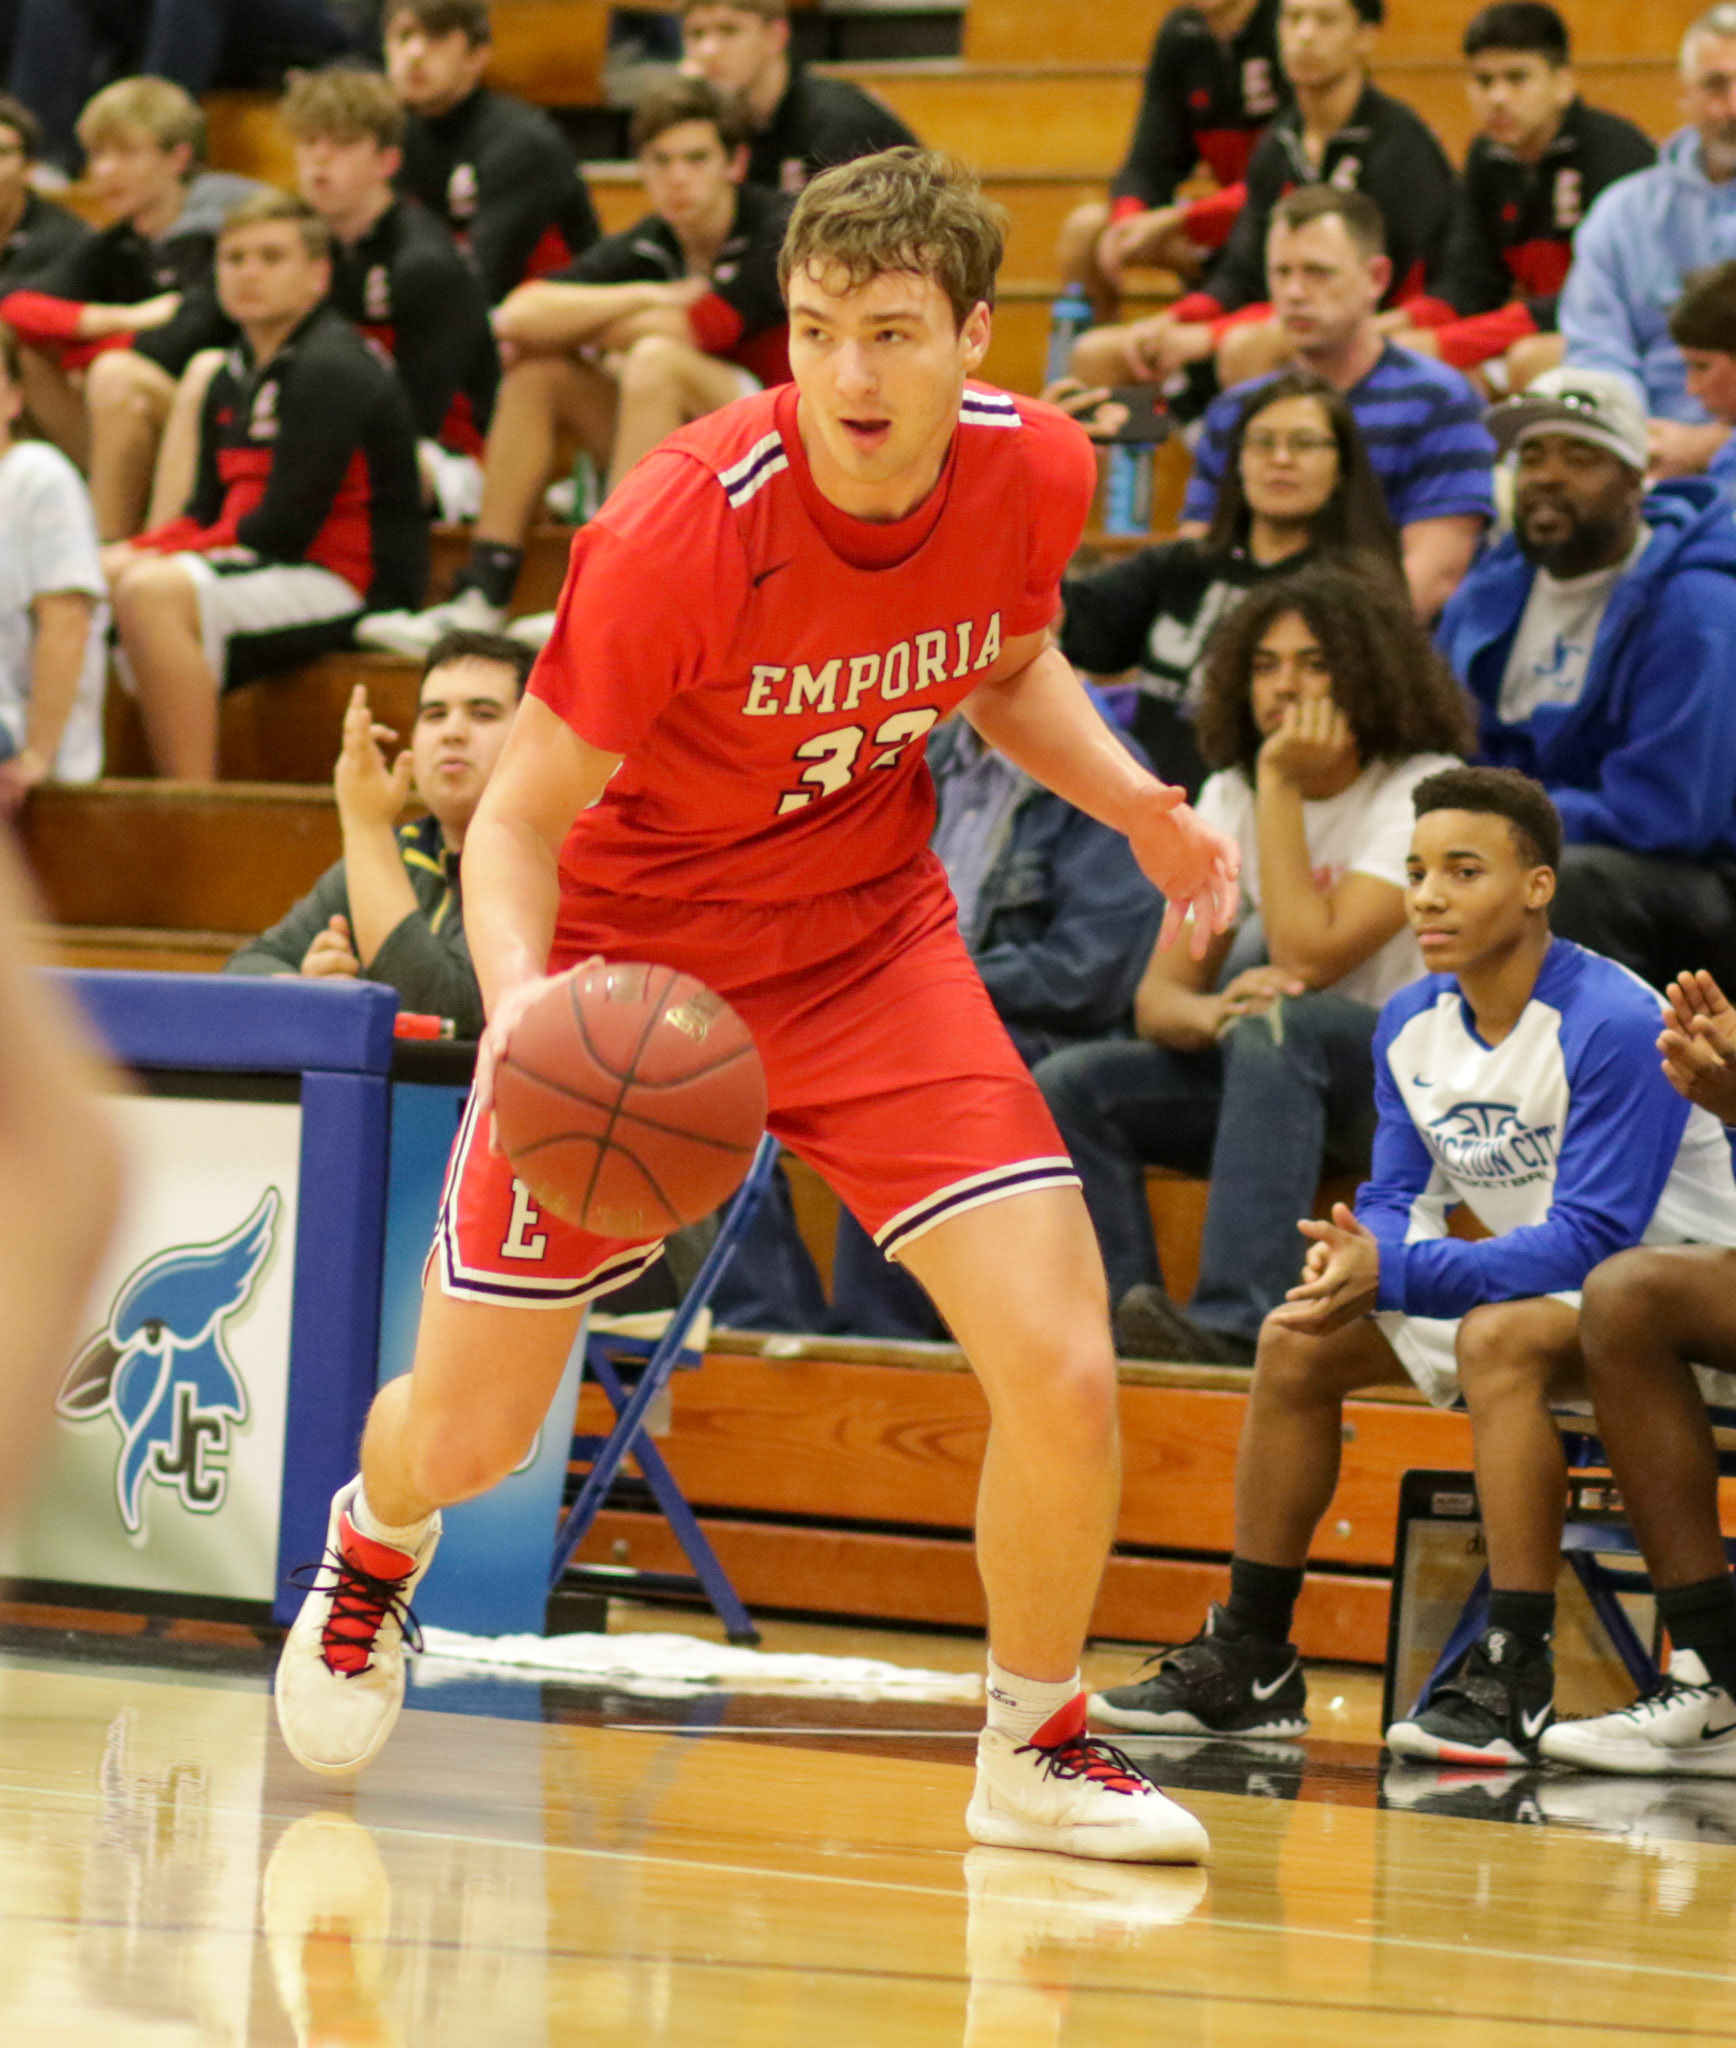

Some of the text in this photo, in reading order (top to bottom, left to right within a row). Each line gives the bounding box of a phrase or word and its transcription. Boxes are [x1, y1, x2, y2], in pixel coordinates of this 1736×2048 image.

[742, 611, 1001, 715] EMPORIA
[1510, 1124, 1557, 1168] CIT
[500, 1177, 547, 1261] E
[153, 1386, 223, 1503] JC
